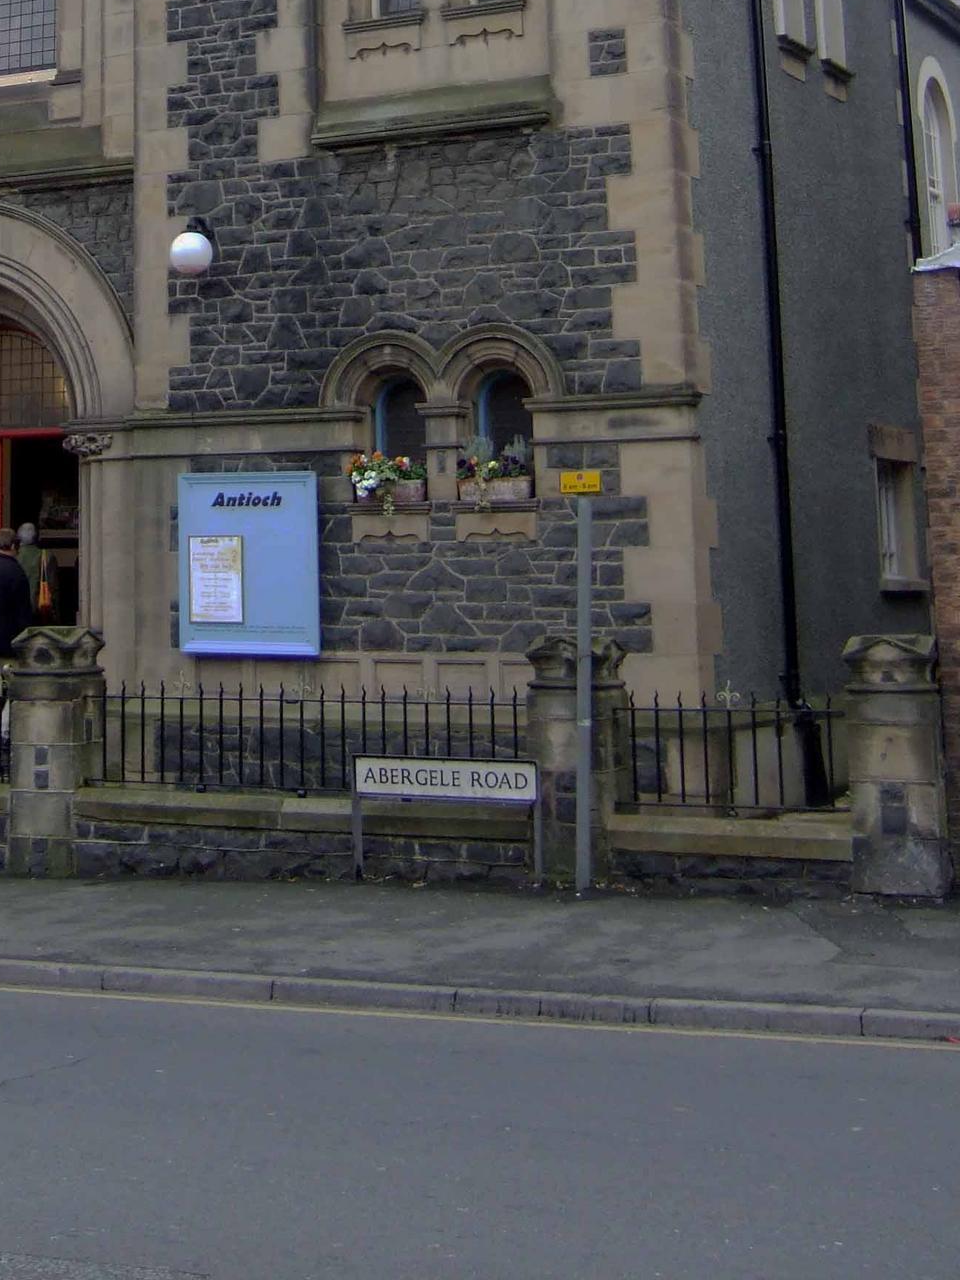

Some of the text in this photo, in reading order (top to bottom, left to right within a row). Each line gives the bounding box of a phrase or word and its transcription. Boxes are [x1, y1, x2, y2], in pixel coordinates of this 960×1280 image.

[211, 491, 282, 507] Antioch
[364, 767, 528, 790] ABERGELE ROAD
